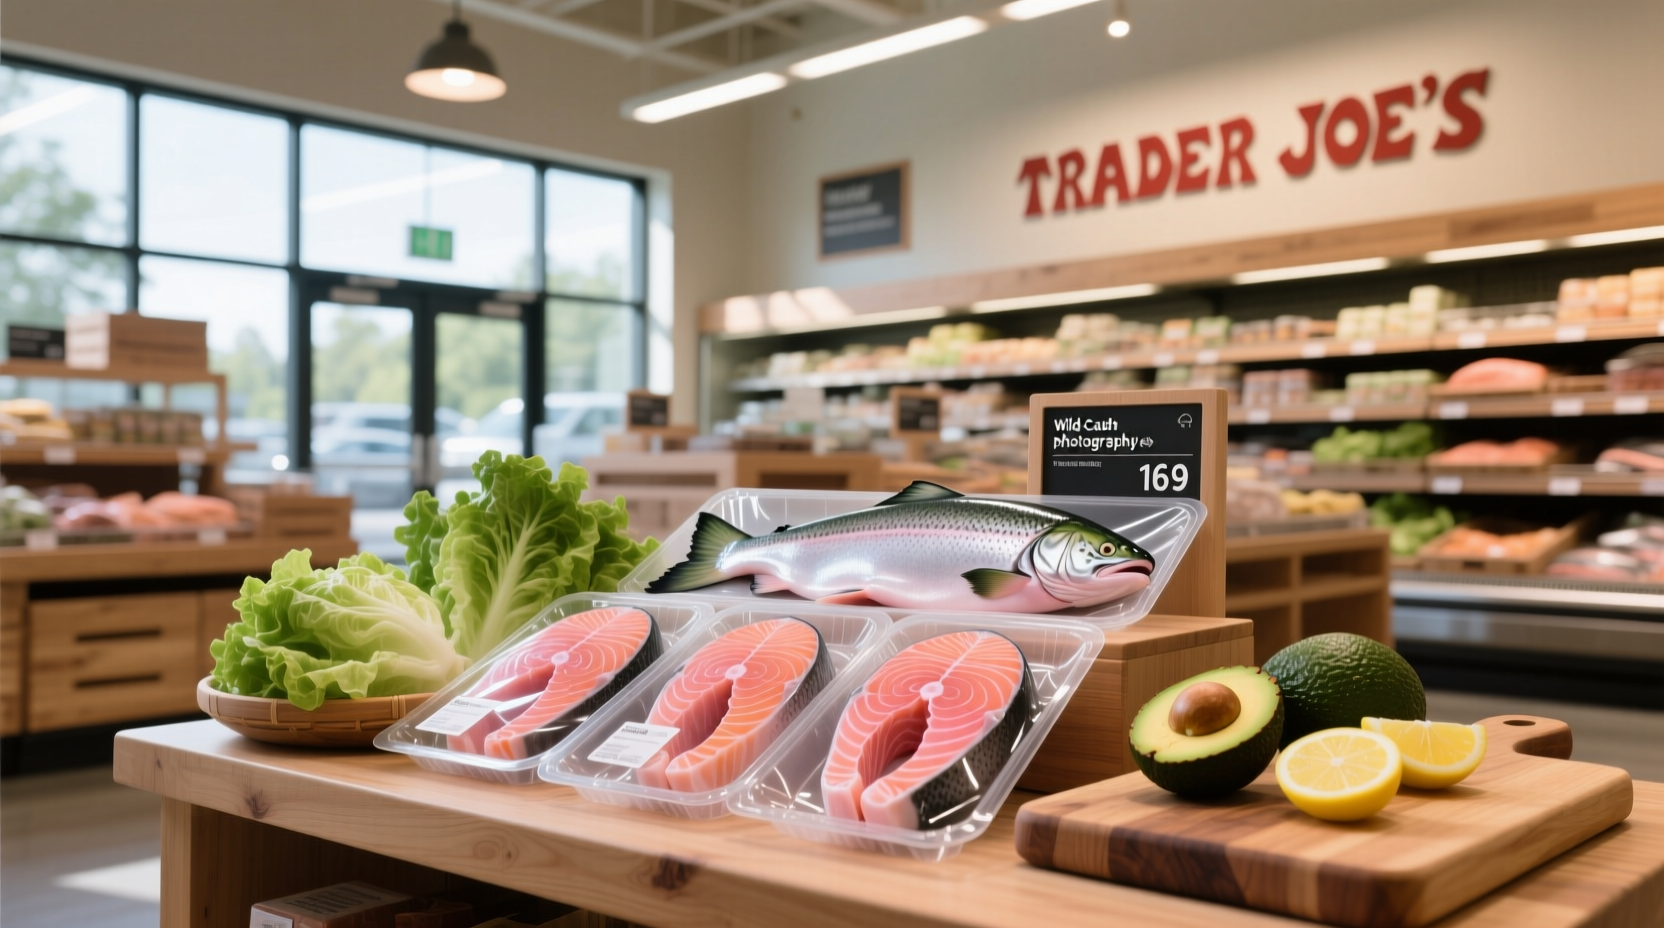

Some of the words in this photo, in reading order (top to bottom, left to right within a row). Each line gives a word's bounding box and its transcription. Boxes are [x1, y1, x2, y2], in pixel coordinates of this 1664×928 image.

[1018, 116, 1257, 218] TRADER
[1278, 67, 1491, 179] JOE'S
[1053, 433, 1139, 451] photography
[1139, 463, 1189, 492] 169
